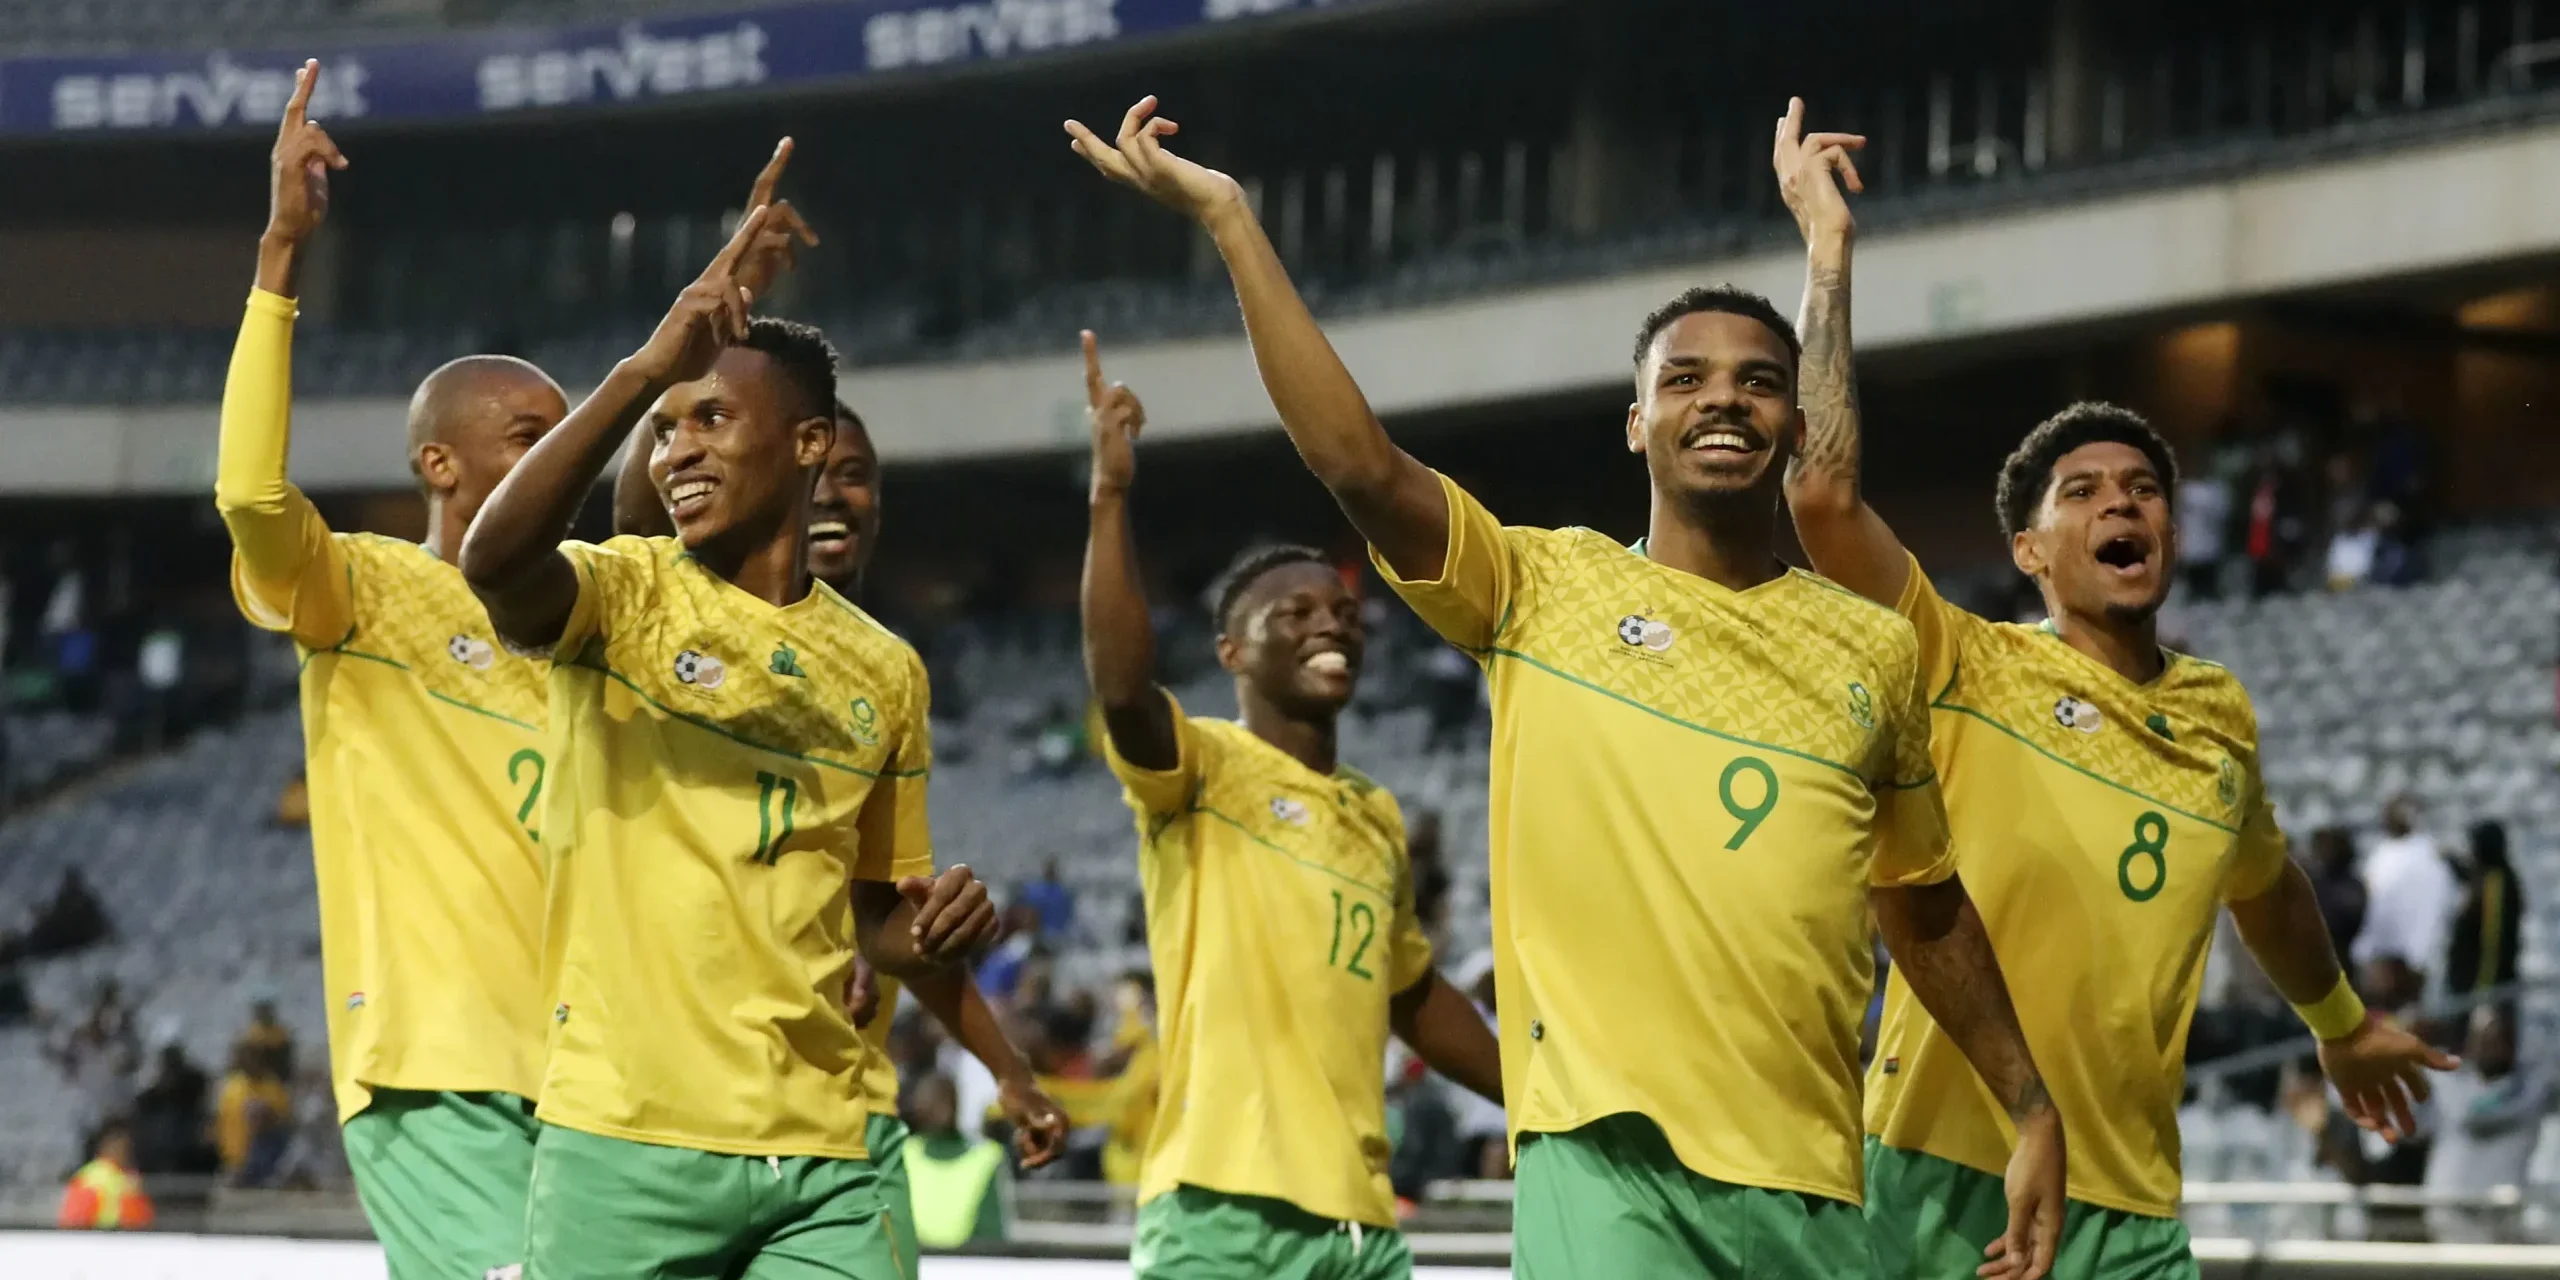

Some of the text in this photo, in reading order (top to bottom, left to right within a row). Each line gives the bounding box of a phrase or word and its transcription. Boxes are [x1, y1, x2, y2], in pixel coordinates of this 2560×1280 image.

[478, 22, 768, 110] servest
[508, 748, 546, 842] 2
[754, 770, 797, 866] 11
[1718, 756, 1779, 850] 9
[2118, 811, 2169, 903] 8
[1328, 888, 1376, 981] 12
